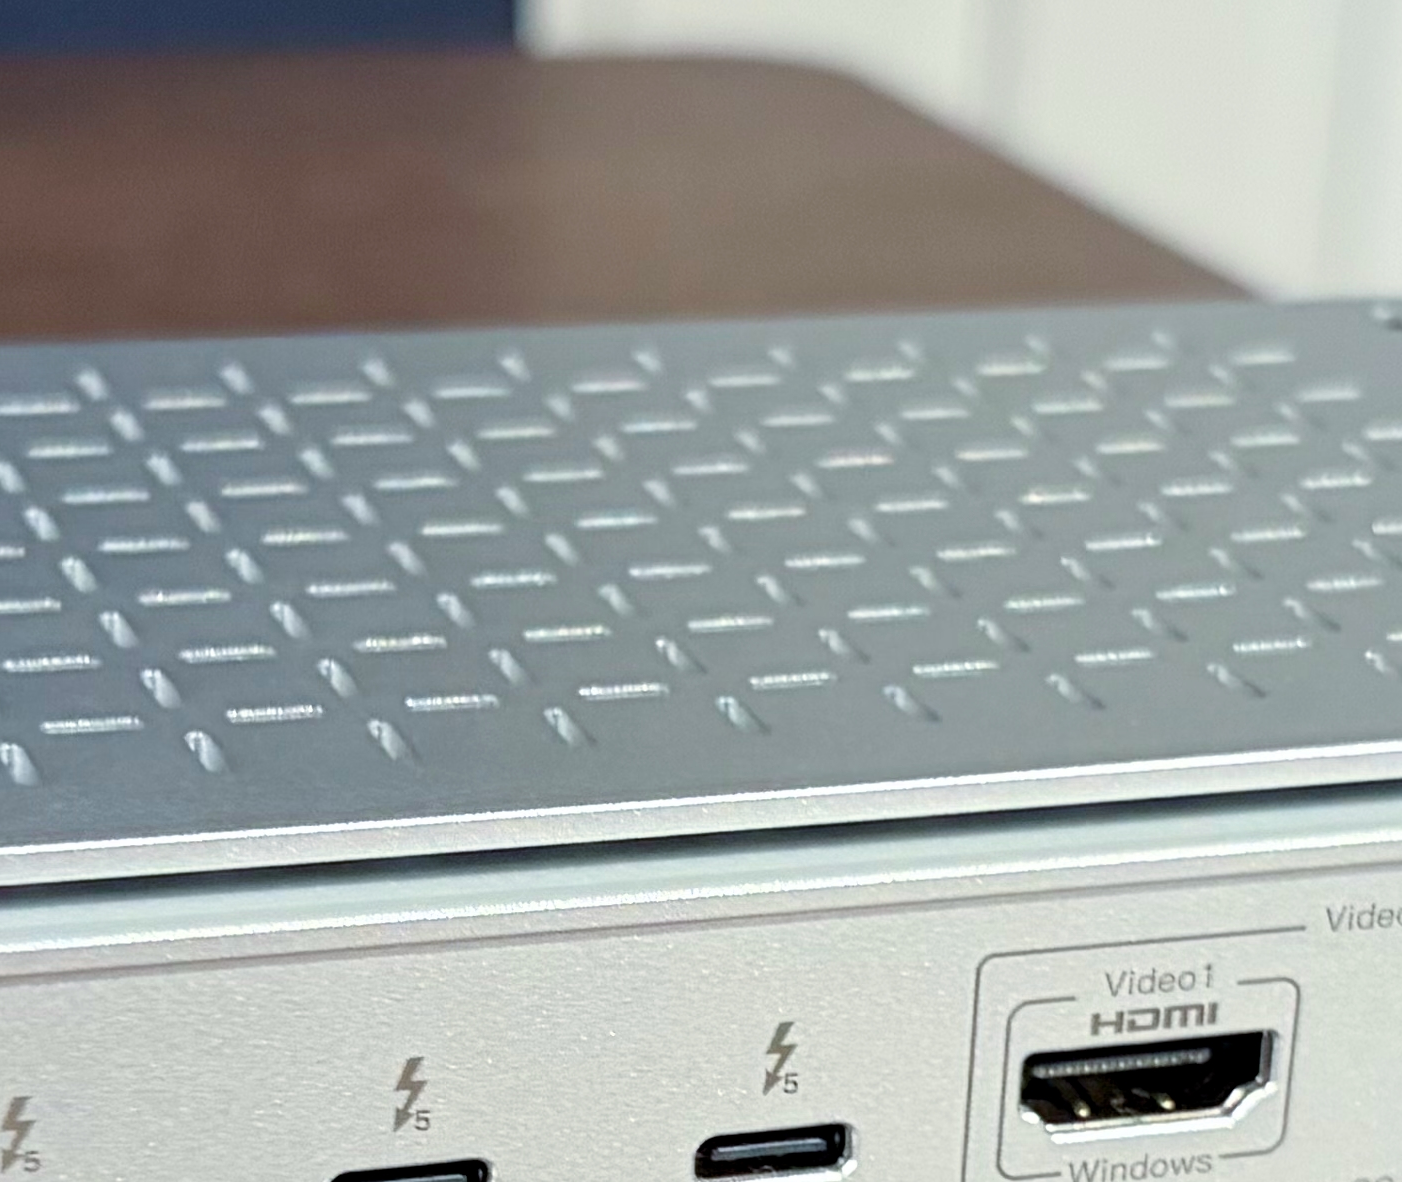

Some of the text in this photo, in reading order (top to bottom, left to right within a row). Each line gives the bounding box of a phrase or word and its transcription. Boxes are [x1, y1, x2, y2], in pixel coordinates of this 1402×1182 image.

[1105, 965, 1214, 996] Video1
[1091, 1002, 1218, 1035] HDMI
[782, 1072, 799, 1094] 5
[414, 1109, 432, 1131] 5
[23, 1151, 41, 1173] 5
